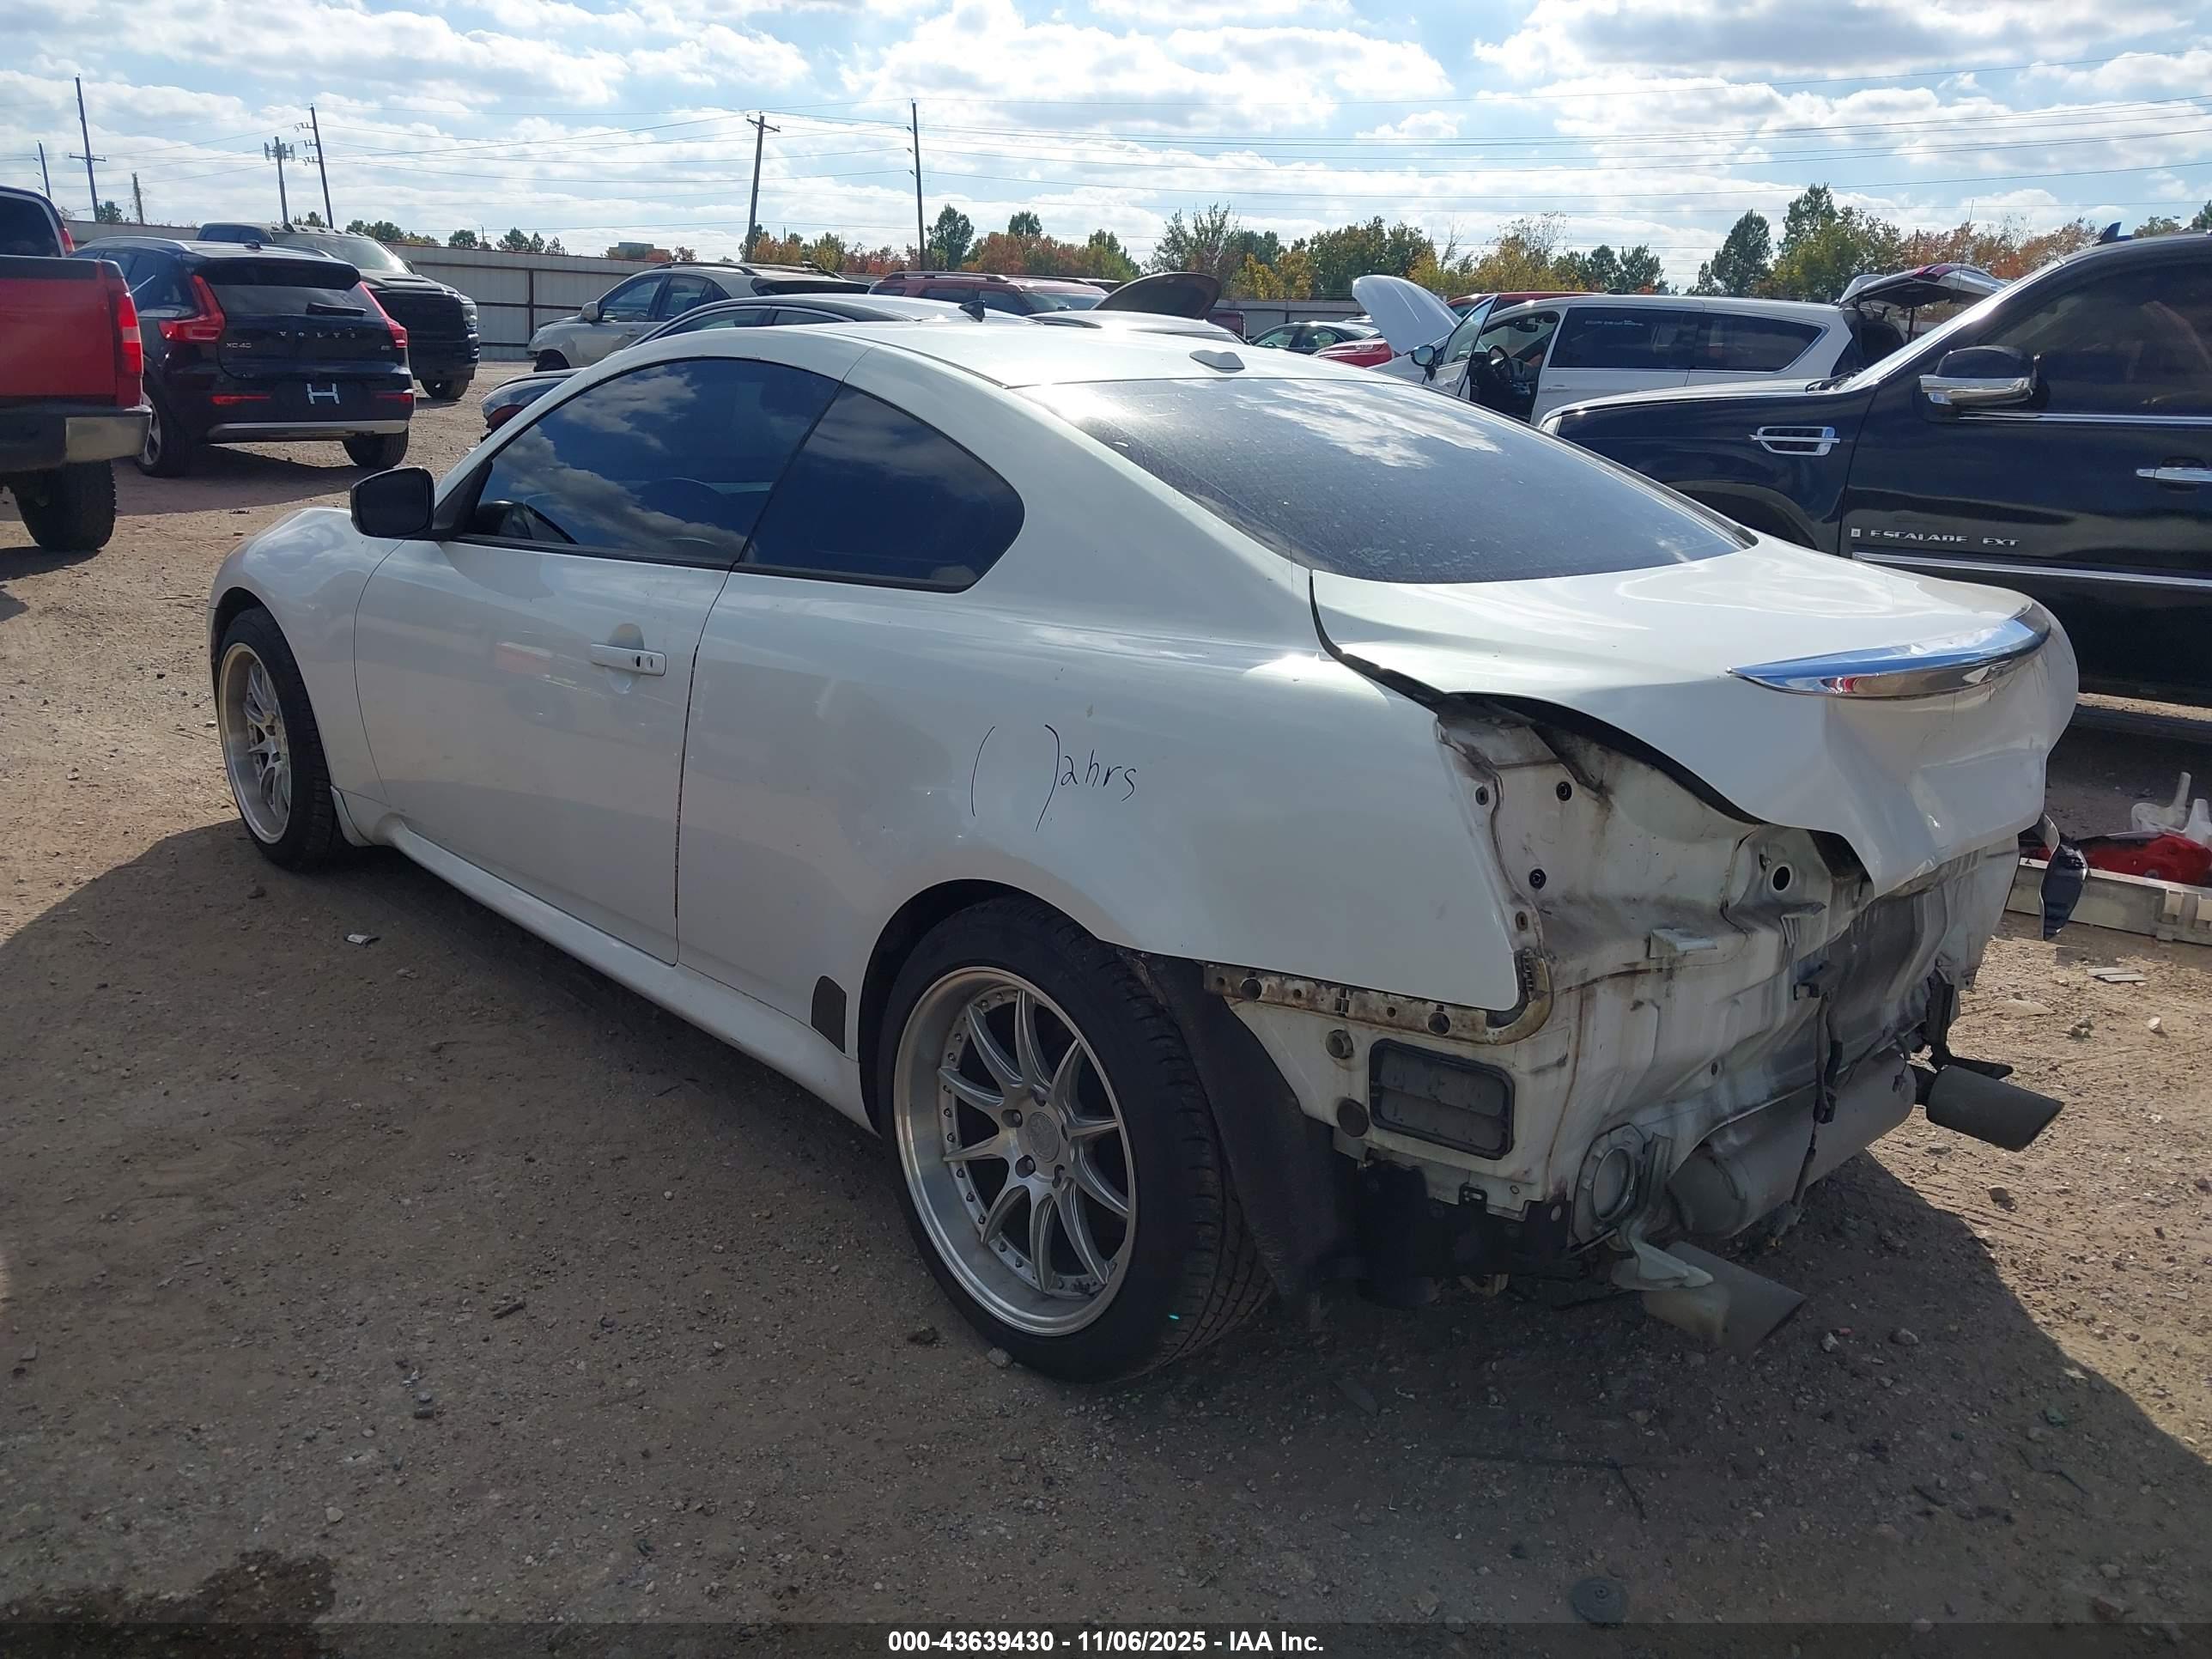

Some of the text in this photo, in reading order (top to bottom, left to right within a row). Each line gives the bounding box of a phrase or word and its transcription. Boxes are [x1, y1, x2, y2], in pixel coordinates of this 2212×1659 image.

[278, 331, 356, 339] VOLVO
[1869, 529, 2020, 547] ESCALADE EXT
